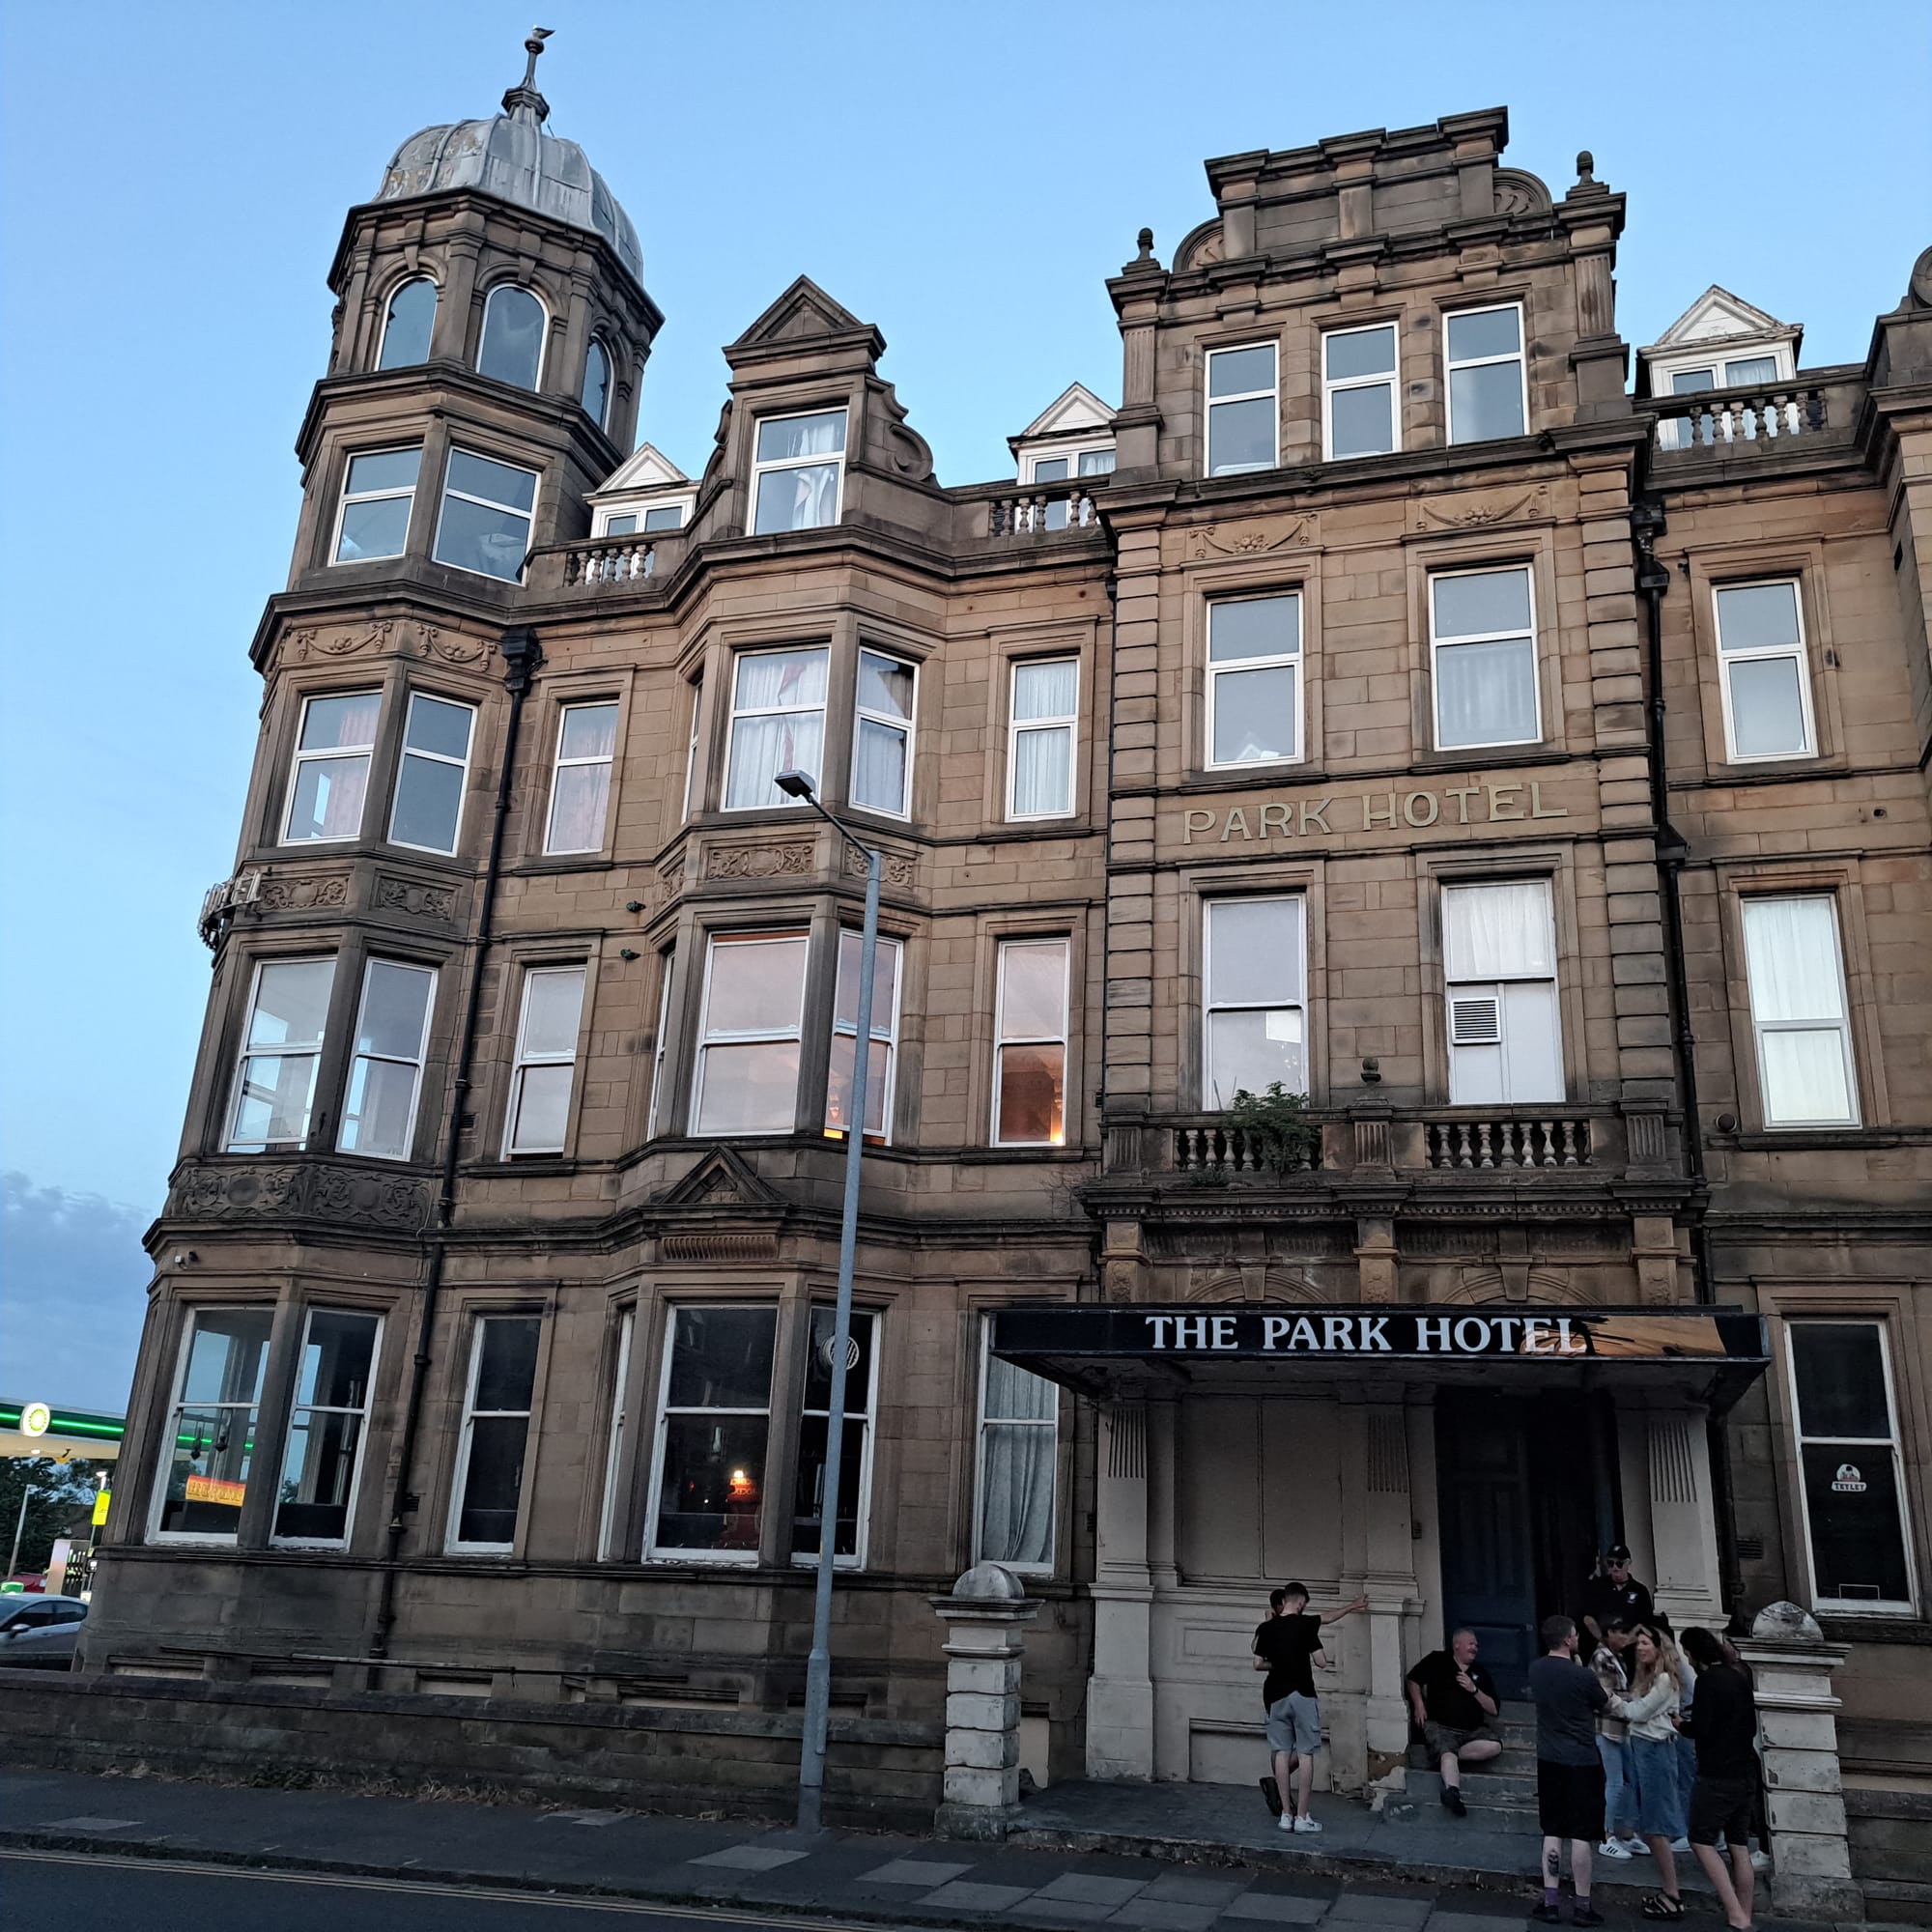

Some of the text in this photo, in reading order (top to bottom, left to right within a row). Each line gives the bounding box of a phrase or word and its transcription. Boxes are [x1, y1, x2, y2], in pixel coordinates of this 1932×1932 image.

[1182, 781, 1568, 845] PARK HOTEL
[1145, 1316, 1587, 1352] THE PARK HOTEL
